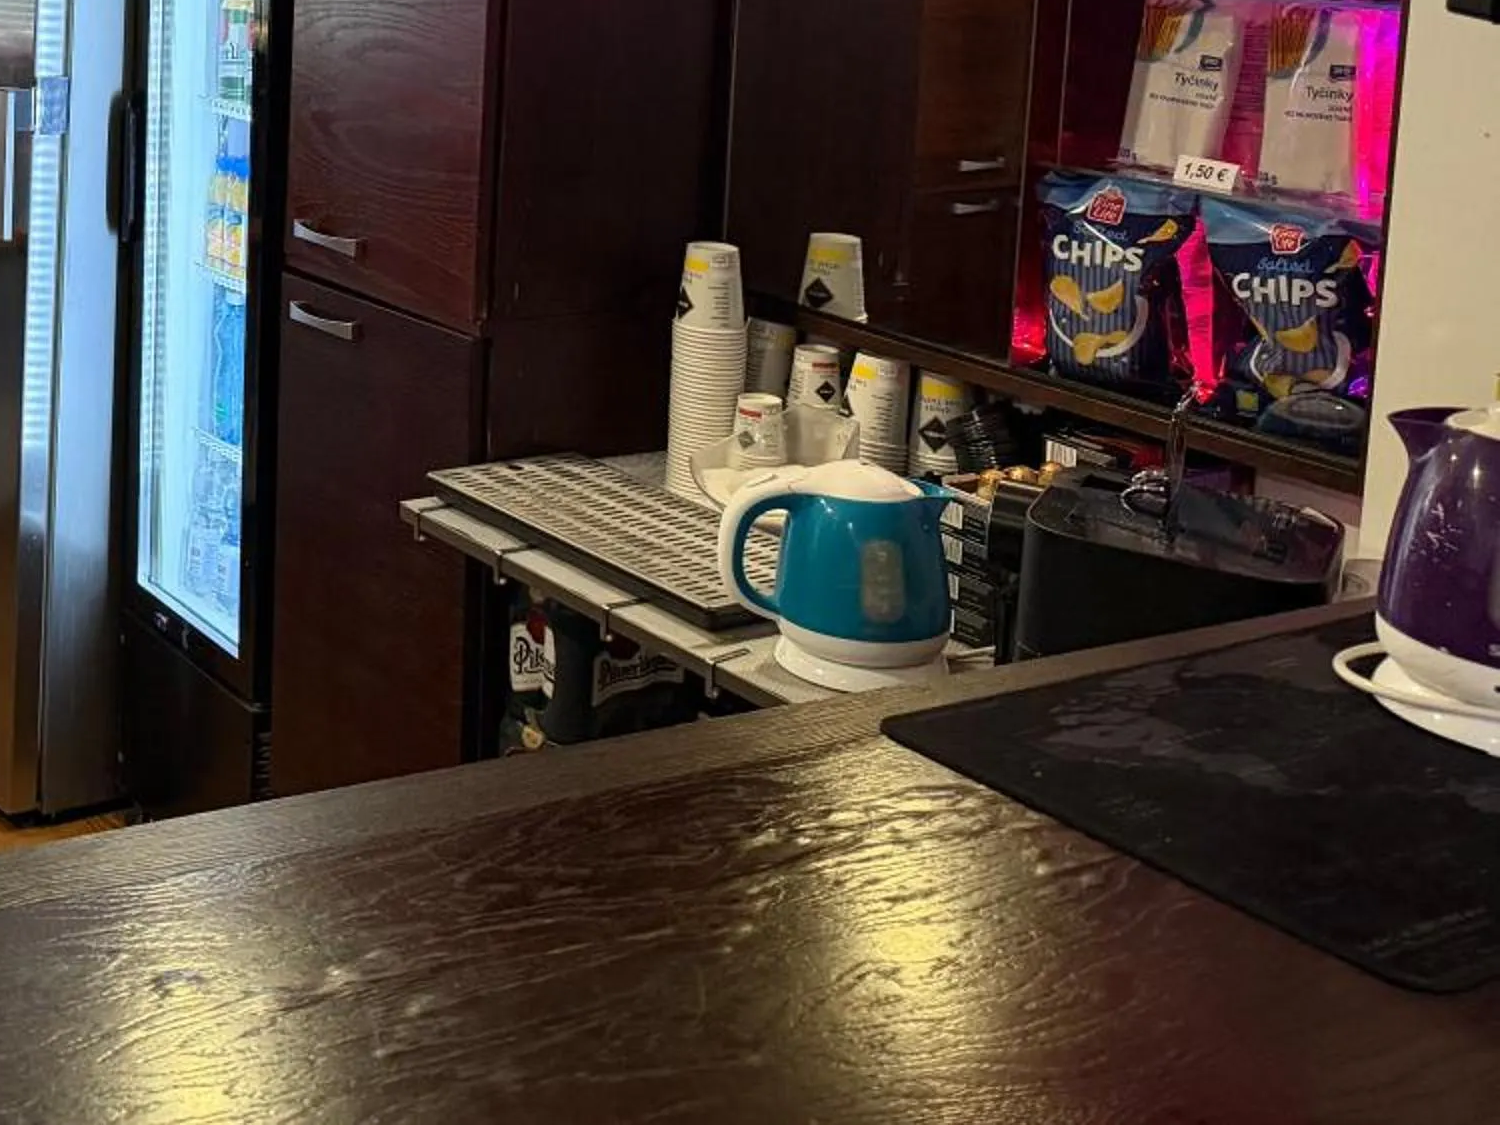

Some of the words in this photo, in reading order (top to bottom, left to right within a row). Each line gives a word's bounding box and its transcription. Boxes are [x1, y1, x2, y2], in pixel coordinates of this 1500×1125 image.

[1184, 162, 1214, 180] 1,50
[1217, 168, 1230, 182] €
[1052, 234, 1145, 272] CHIPS
[1232, 272, 1339, 308] CHIPS
